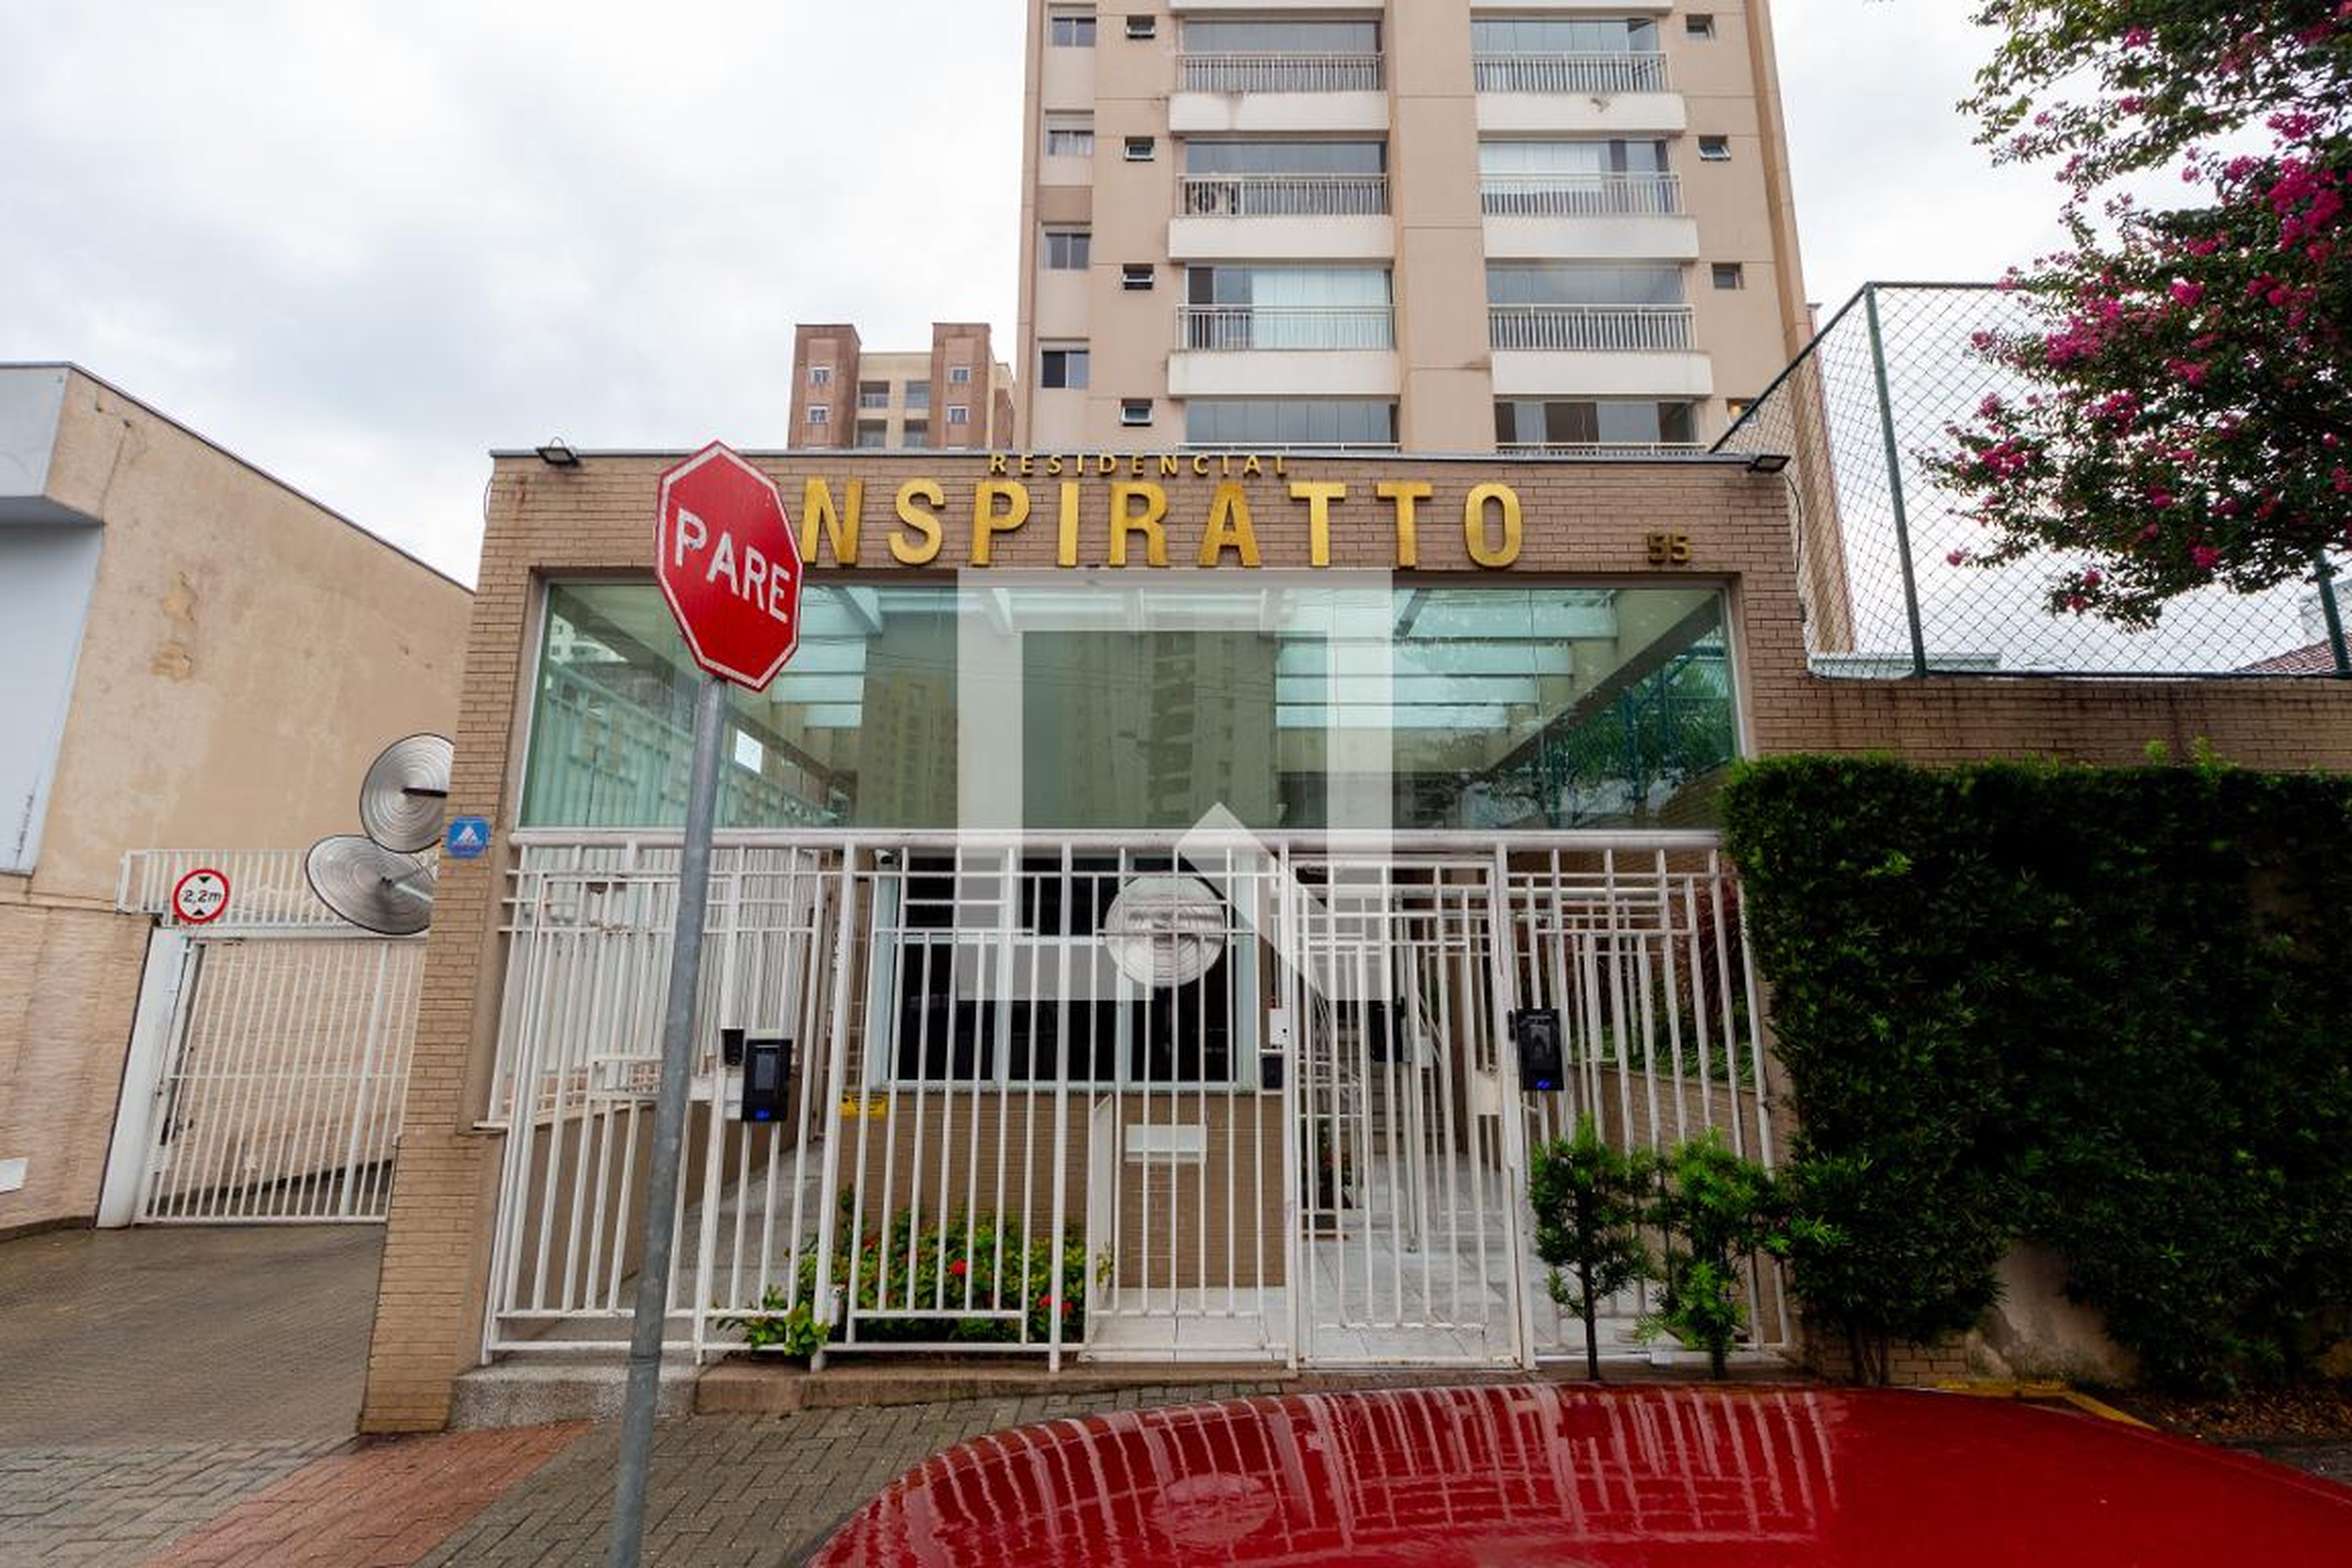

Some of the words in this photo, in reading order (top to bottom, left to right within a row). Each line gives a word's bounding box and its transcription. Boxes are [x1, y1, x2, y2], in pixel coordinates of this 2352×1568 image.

[990, 453, 1287, 476] RESIDENCIAL
[800, 475, 1523, 570] NSPIRATTO
[675, 507, 791, 624] PARE
[183, 889, 222, 905] 2,2m
